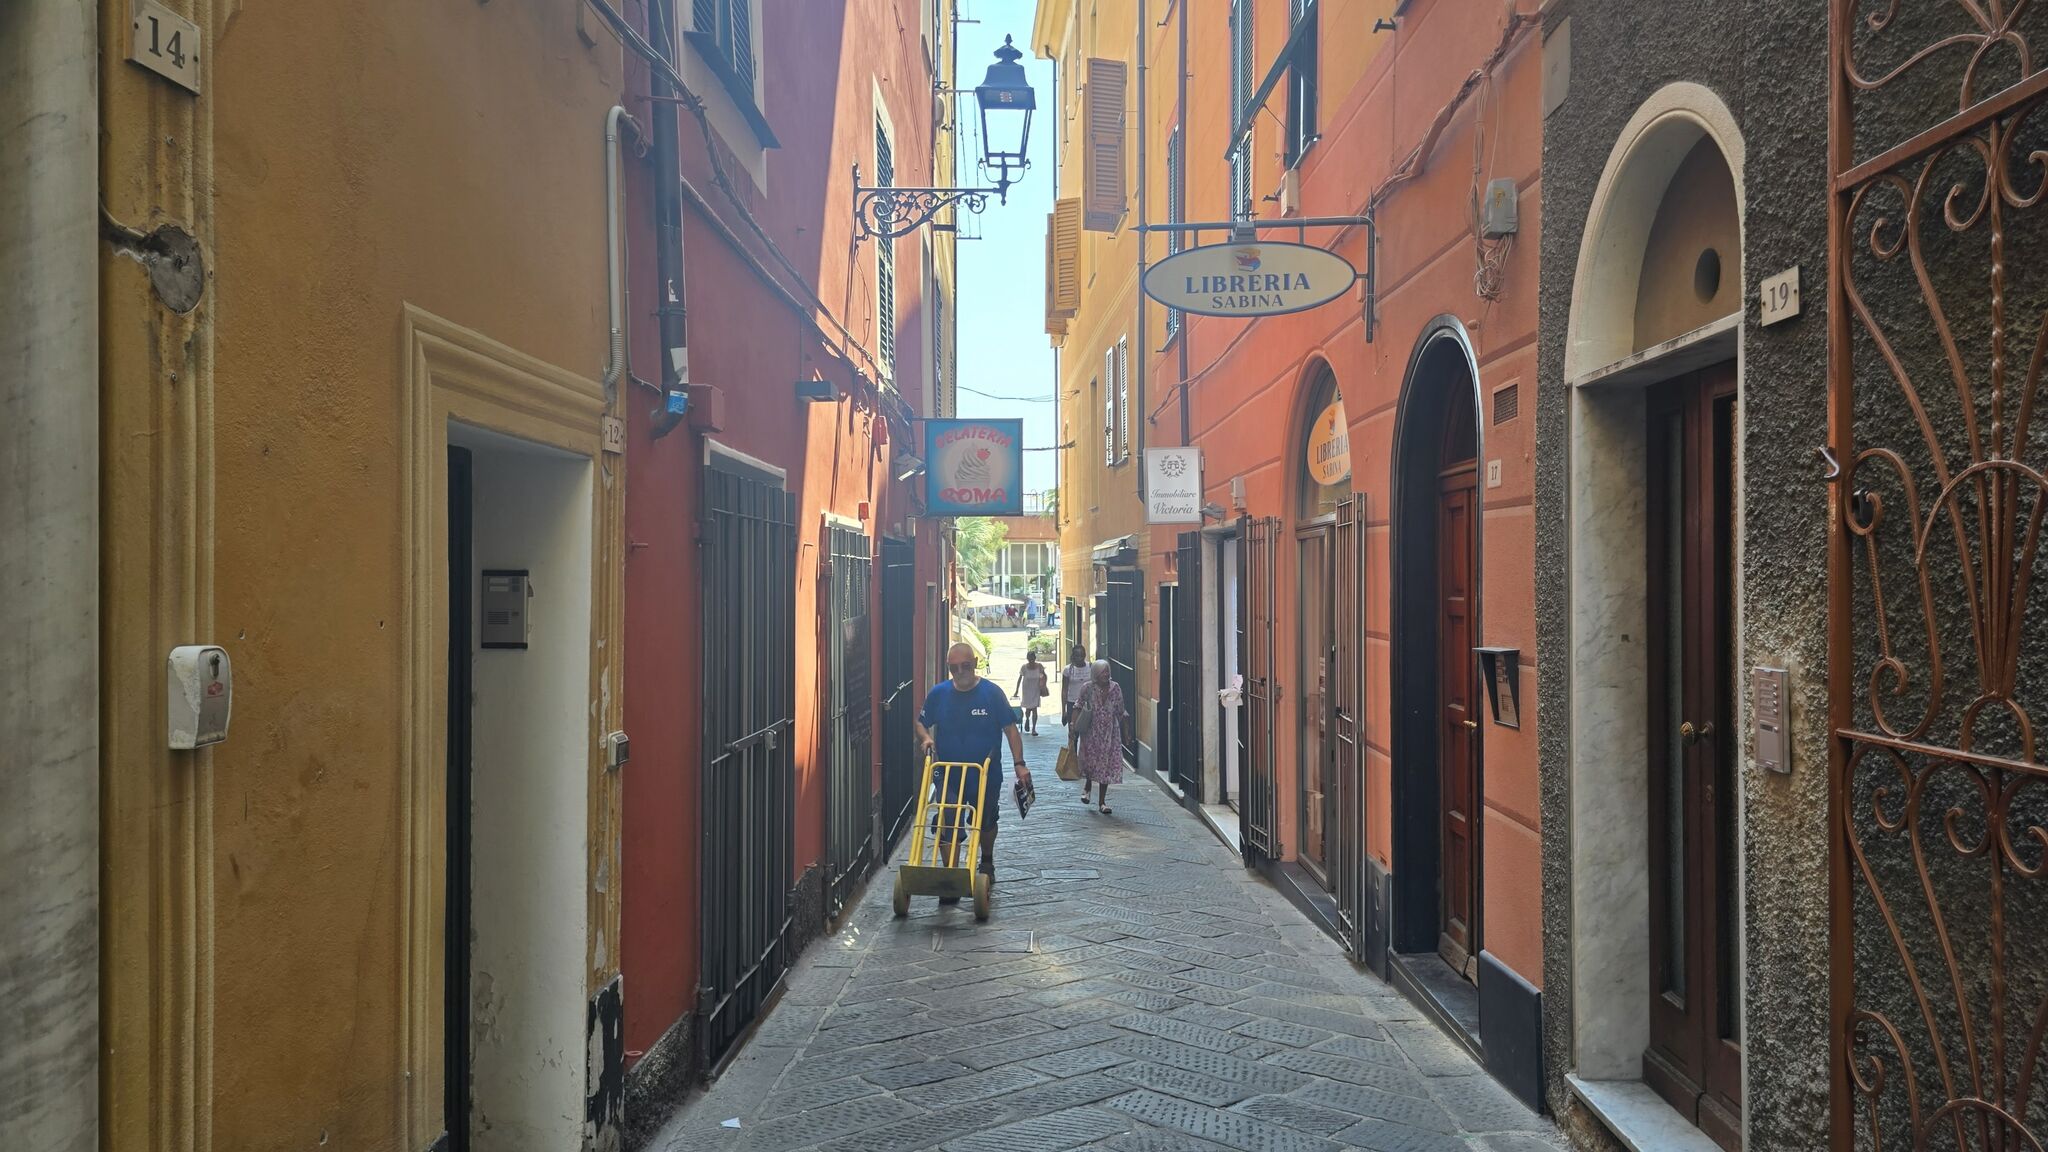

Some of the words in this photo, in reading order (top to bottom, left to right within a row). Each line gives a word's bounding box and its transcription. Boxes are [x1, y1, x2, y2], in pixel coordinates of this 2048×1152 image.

[148, 16, 185, 69] 14
[1185, 272, 1311, 294] LIBRERIA
[1212, 294, 1284, 309] SABINA
[1769, 281, 1789, 313] 19
[609, 424, 619, 444] 12
[936, 426, 1013, 448] GELATERIA
[1317, 435, 1348, 464] LIBRERIA
[1322, 459, 1342, 479] SABINA
[1491, 465, 1498, 481] 17
[938, 487, 1008, 504] ROMA
[1150, 488, 1197, 499] Immobiliare
[1153, 502, 1193, 515] Victoria
